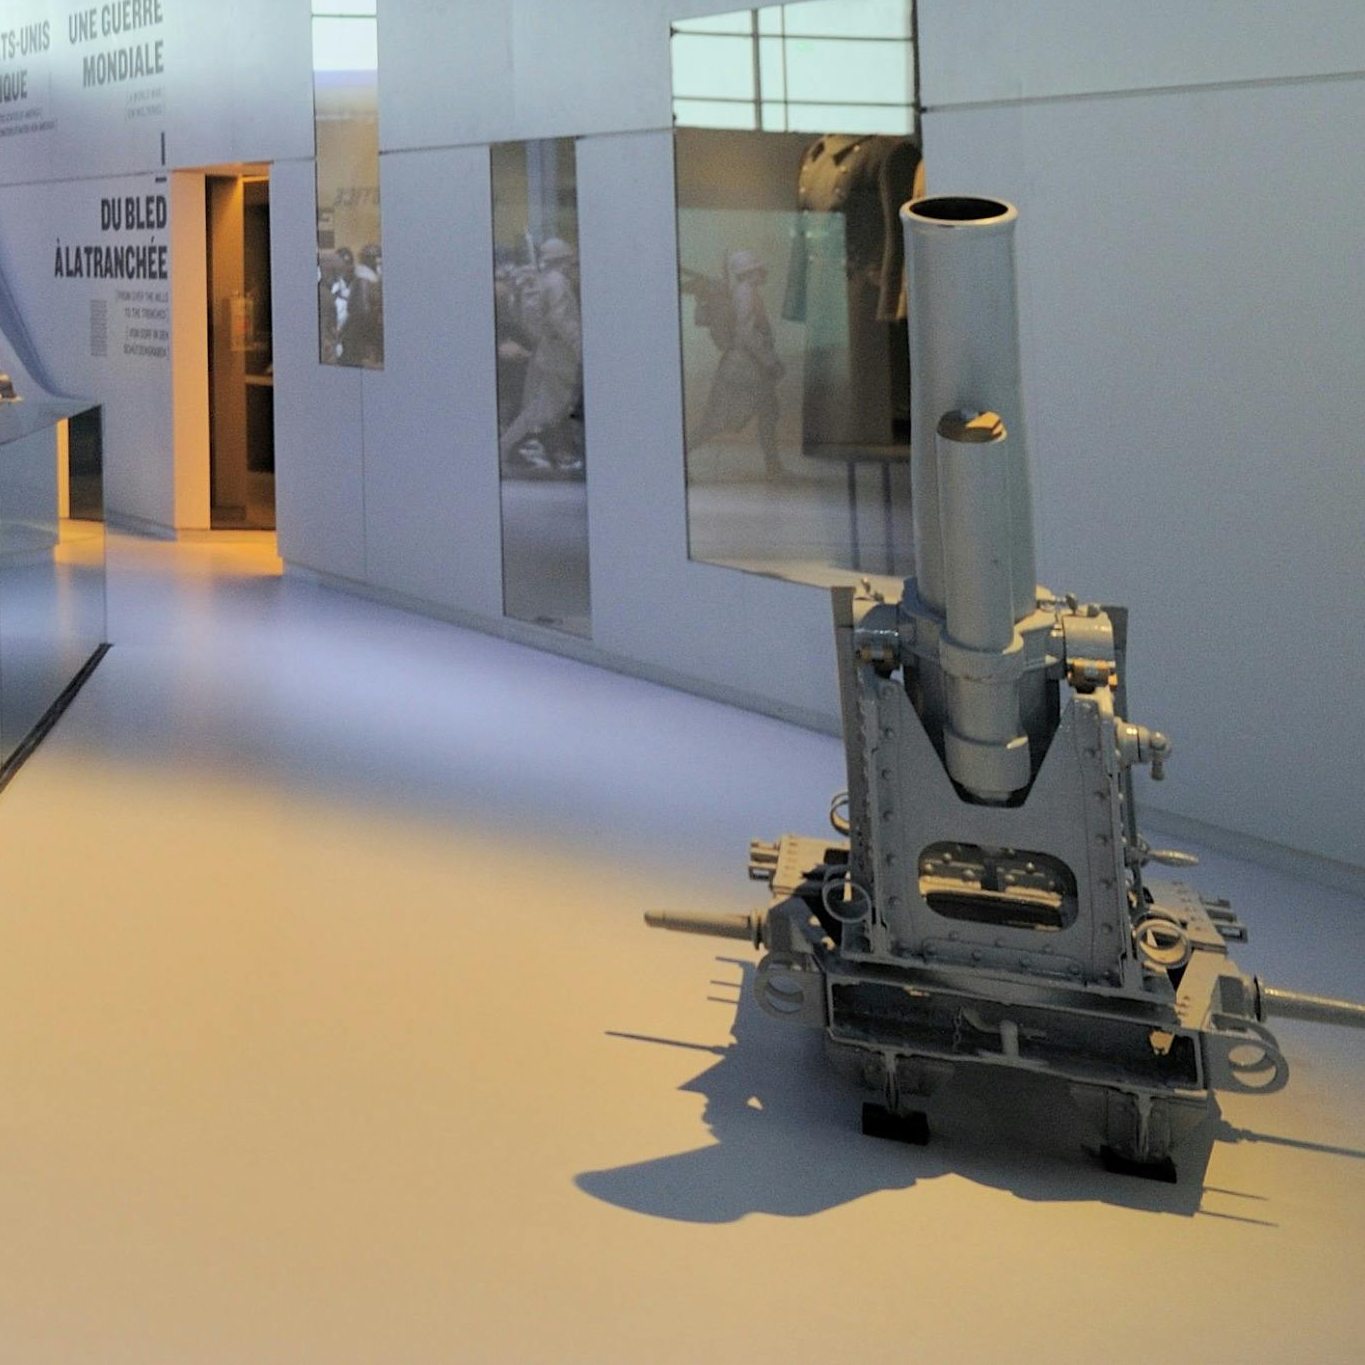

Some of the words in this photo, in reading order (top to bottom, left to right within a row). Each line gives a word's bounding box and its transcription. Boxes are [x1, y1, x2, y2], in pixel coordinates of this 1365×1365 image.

[68, 8, 98, 45] UNE
[82, 40, 165, 88] MONDIALE
[101, 196, 122, 232] DU
[125, 194, 167, 231] BLED
[54, 238, 63, 279] À
[82, 236, 168, 280] TRANCHÉE
